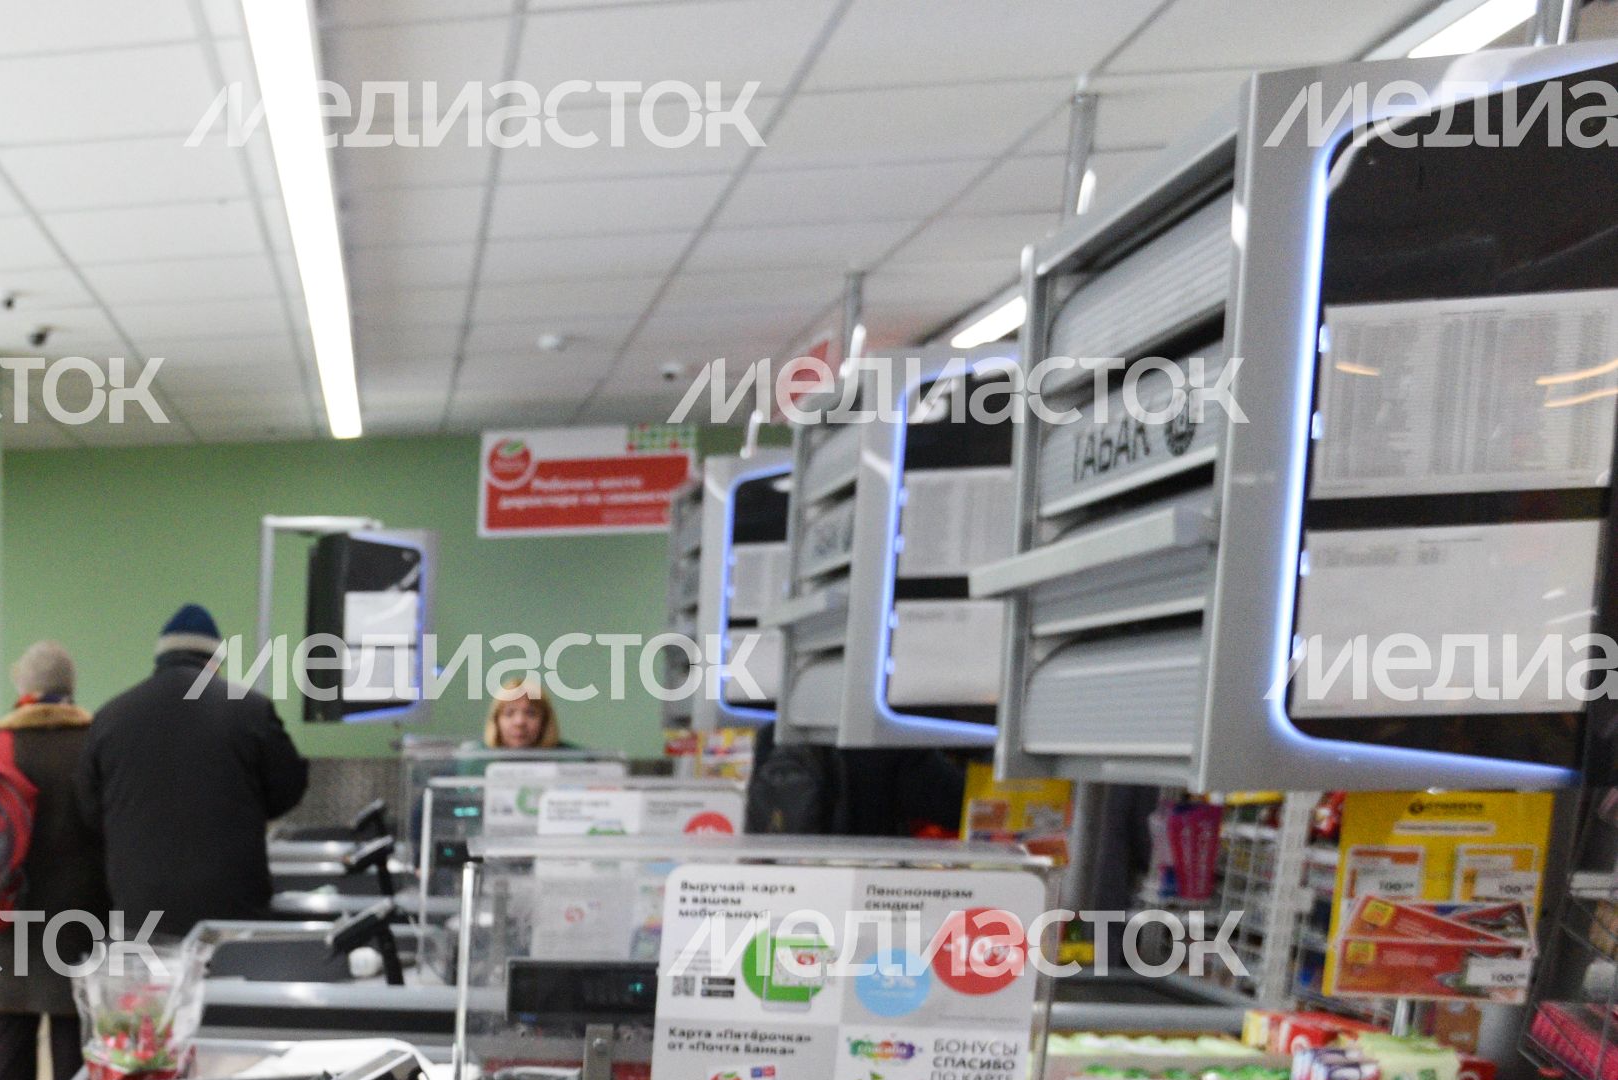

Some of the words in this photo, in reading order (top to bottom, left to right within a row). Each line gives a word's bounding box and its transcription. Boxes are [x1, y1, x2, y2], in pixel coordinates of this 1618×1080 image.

[681, 881, 795, 895] Выручай-карта
[866, 885, 974, 900] Пенсионерам
[691, 896, 742, 906] вашем
[668, 1026, 712, 1040] Карта
[667, 1041, 684, 1051] от
[934, 1038, 1019, 1056] БОНУСЫ
[933, 1056, 1016, 1071] СПАСИБО
